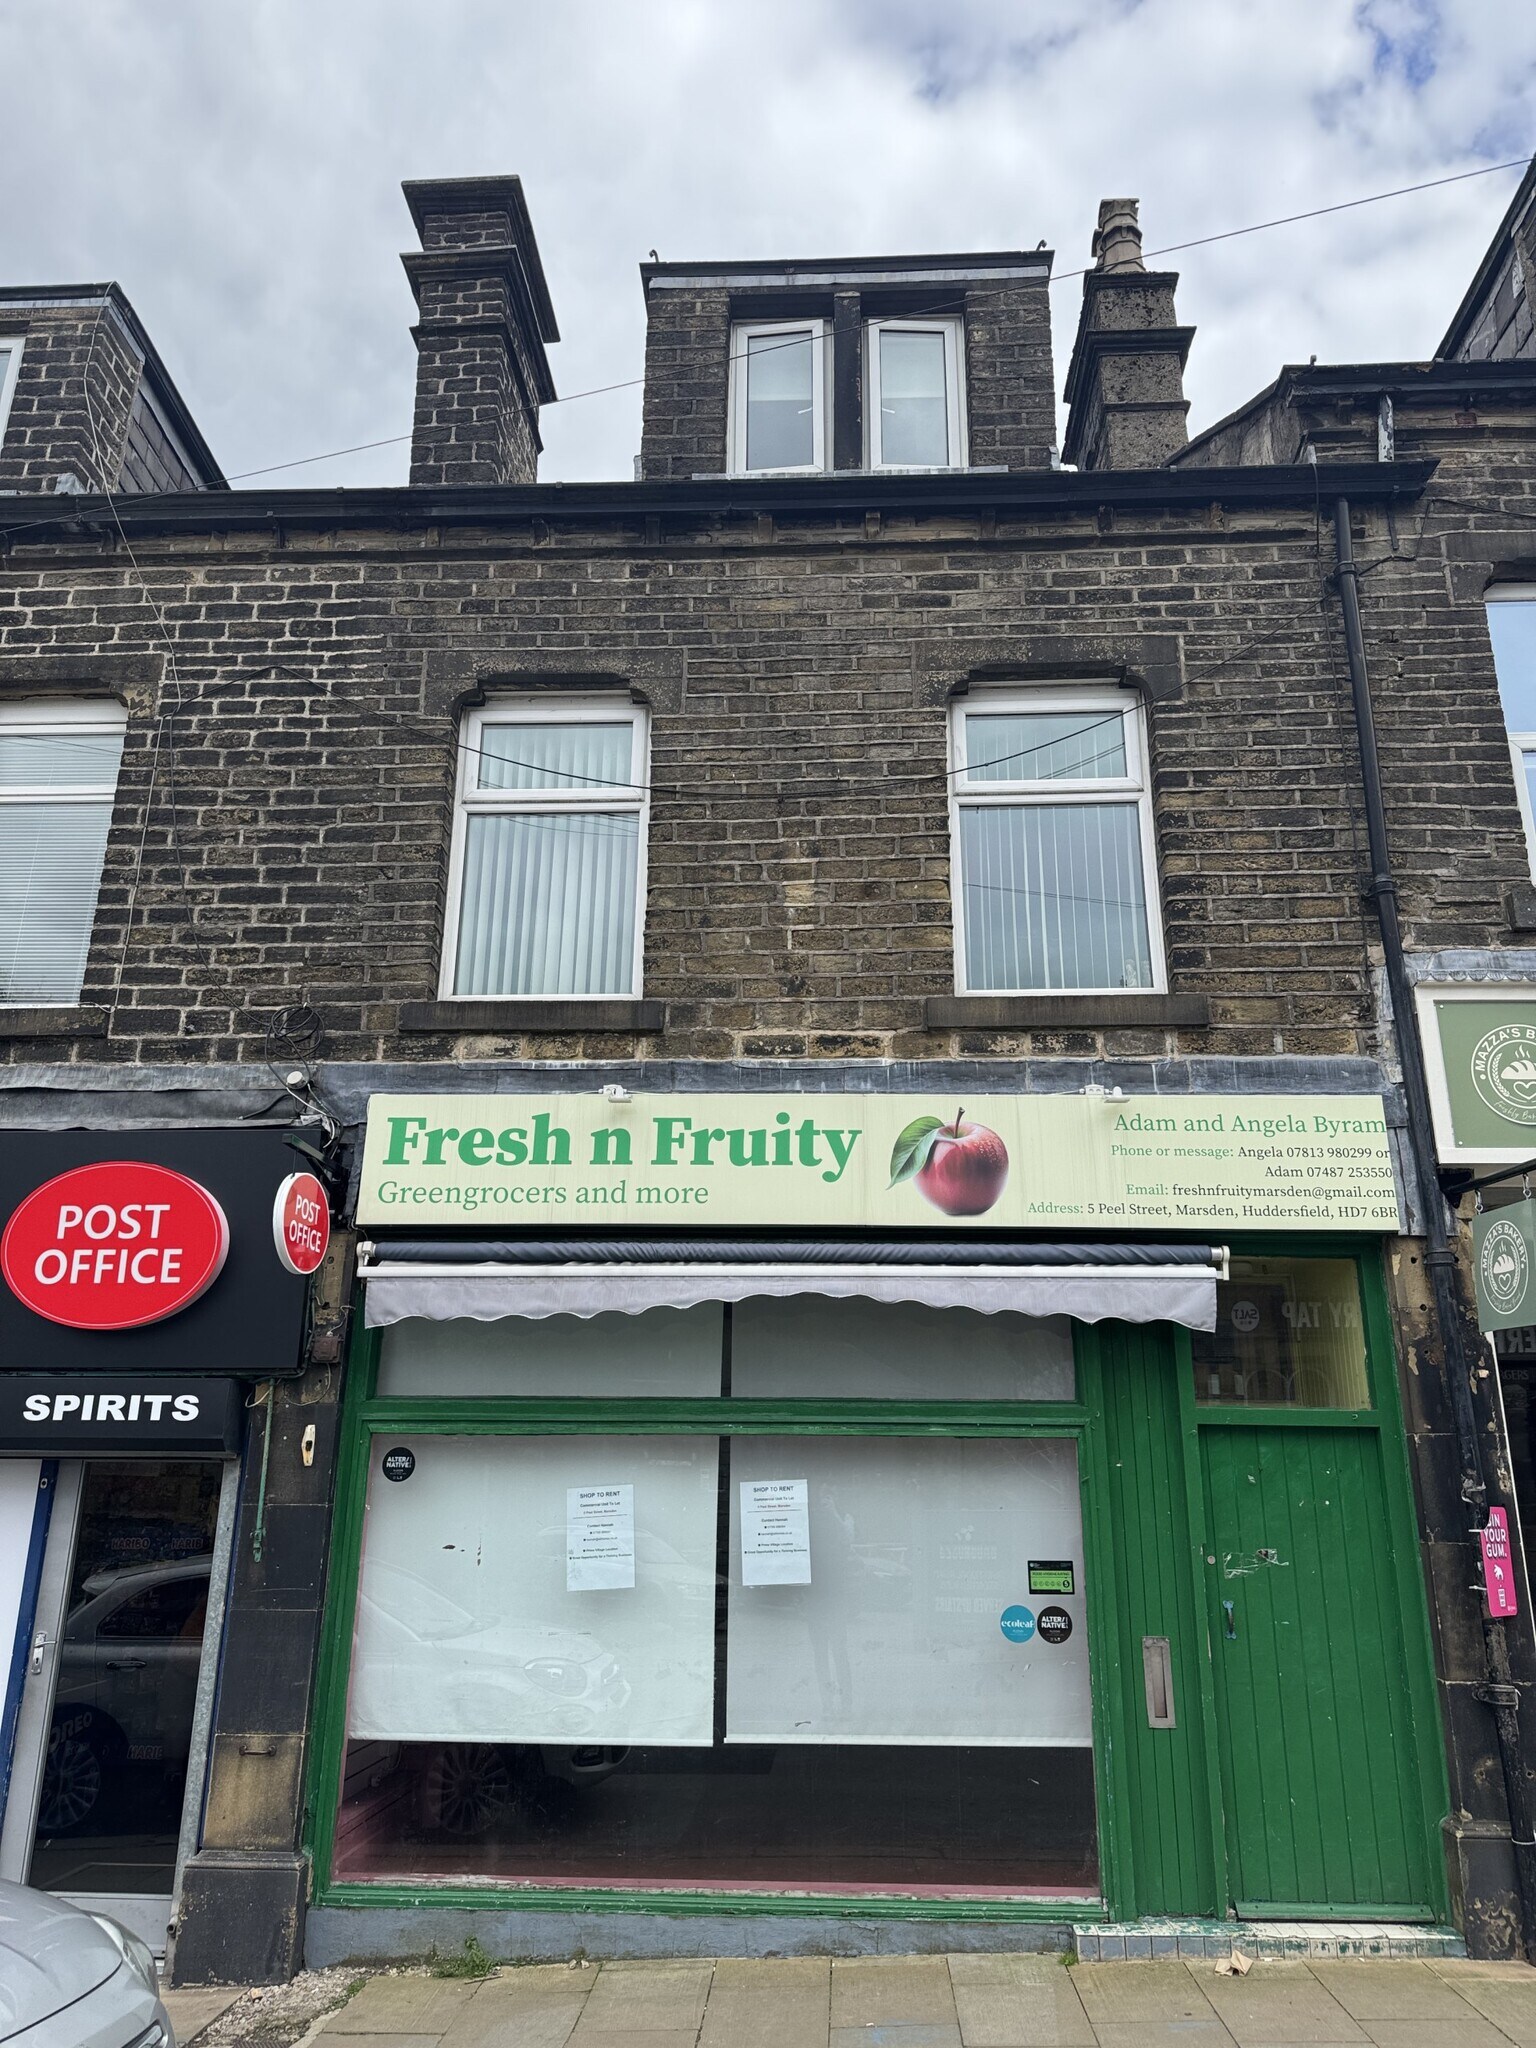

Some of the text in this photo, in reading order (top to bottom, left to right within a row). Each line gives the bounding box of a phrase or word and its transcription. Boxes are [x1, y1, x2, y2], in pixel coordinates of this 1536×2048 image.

[1475, 1027, 1536, 1071] MAZZA'S B
[1114, 1113, 1388, 1139] Adam and Angela Byram
[382, 1111, 863, 1184] Fresh n Fruity
[1111, 1144, 1391, 1161] Phone or message: Angela 07813 980299 or
[1265, 1166, 1393, 1179] Adam 07487 253550
[377, 1179, 709, 1212] Greengrocers and more
[1126, 1183, 1396, 1201] Email: freshnfruitymarsden@gmail.com
[56, 1204, 171, 1240] POST
[295, 1193, 321, 1226] POST
[1027, 1202, 1398, 1220] Address: 5 Peel Street, Marsden, Huddersfield, HD7 6BR
[288, 1219, 322, 1254] OFFICE
[1482, 1223, 1528, 1269] MAZZA'S BAKERY
[34, 1248, 183, 1285] OFFICE
[23, 1394, 200, 1421] SPIRITS
[111, 1537, 151, 1550] HARIBO
[1484, 1528, 1506, 1543] YOUR
[1486, 1543, 1508, 1558] GUM.
